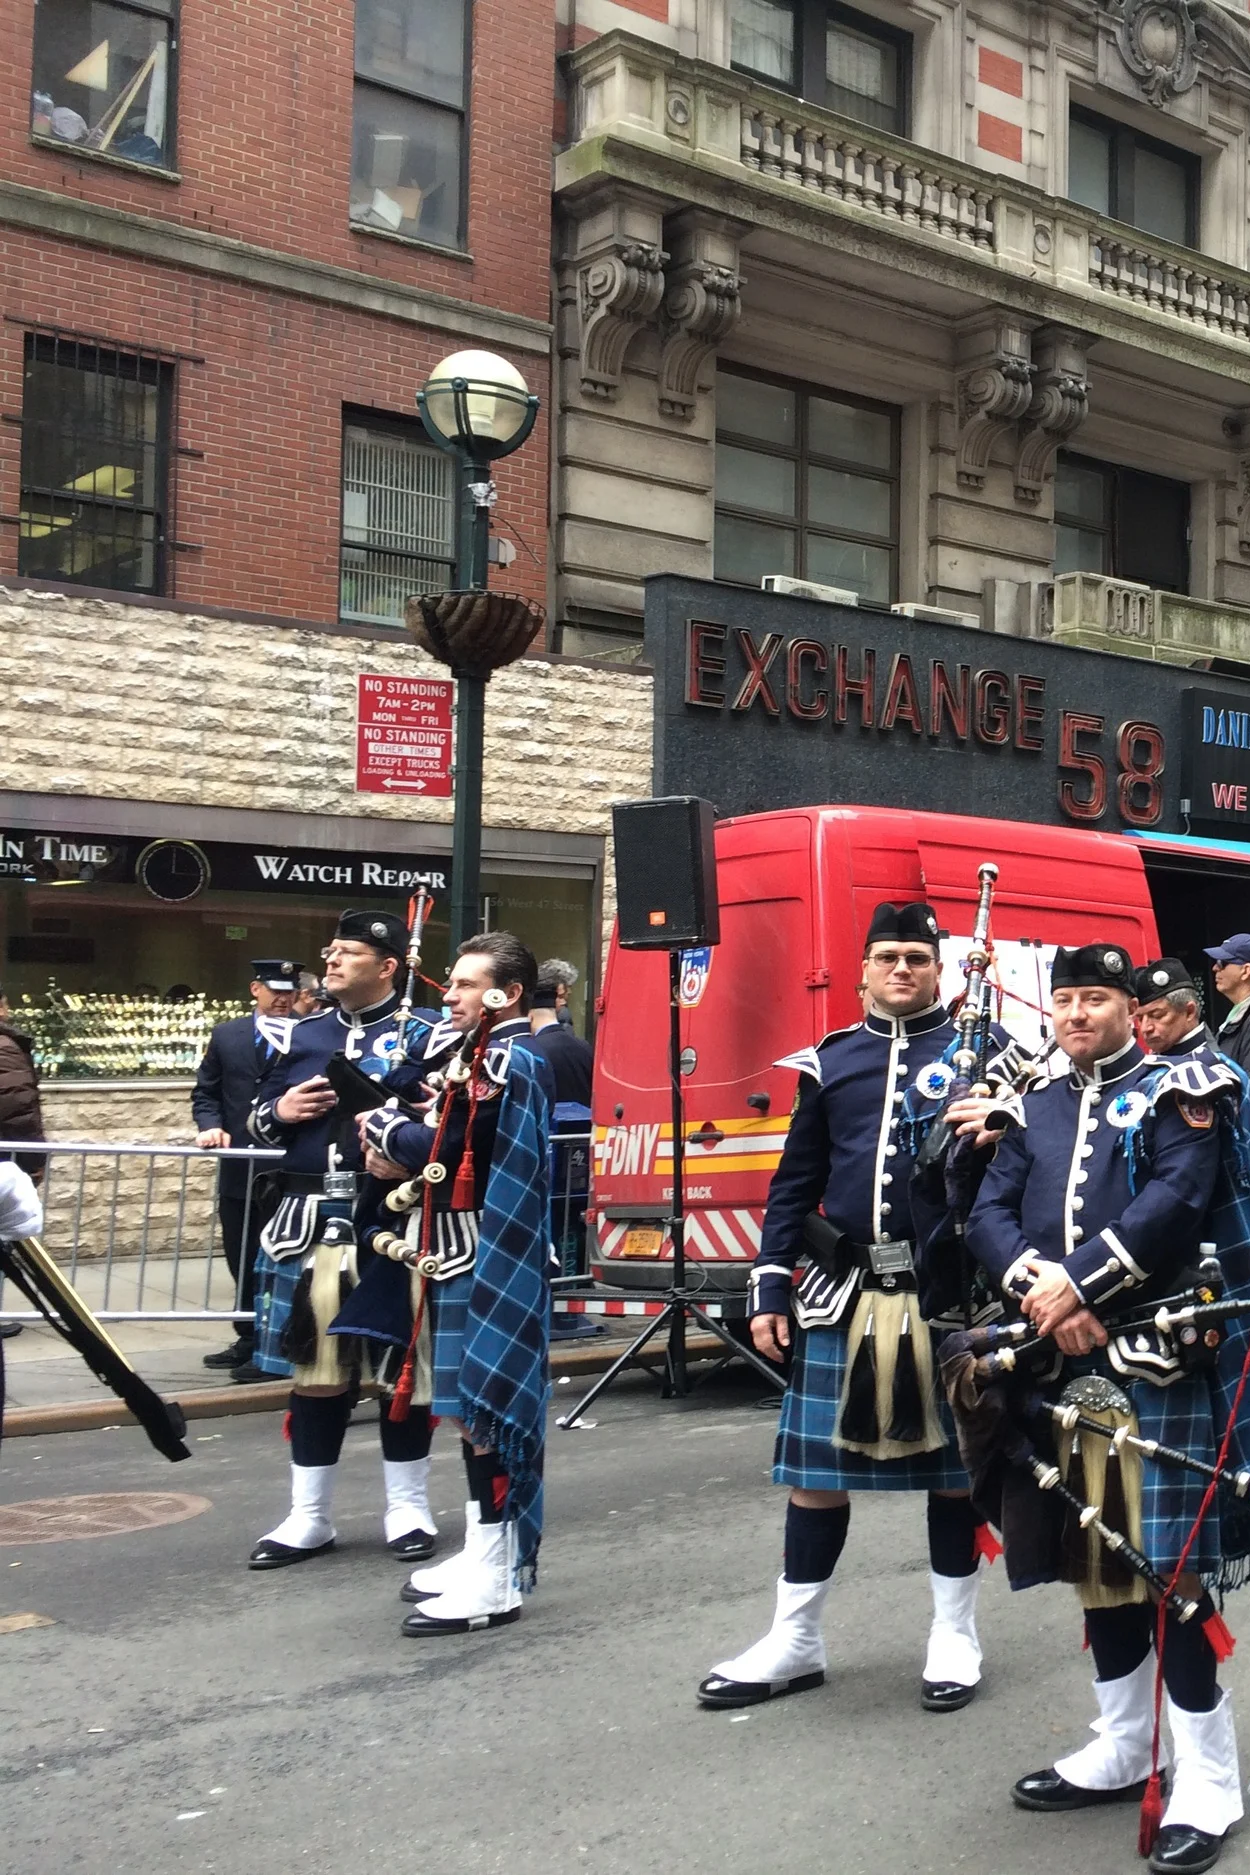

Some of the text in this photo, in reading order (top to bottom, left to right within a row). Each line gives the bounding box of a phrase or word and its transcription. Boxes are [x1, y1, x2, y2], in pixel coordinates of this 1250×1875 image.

[365, 679, 447, 697] NO STANDING
[684, 617, 1047, 752] EXCHANGE
[372, 712, 396, 722] MON
[421, 716, 439, 725] FRI
[364, 728, 446, 745] NO STANDING
[373, 744, 436, 756] OTHER TIMES
[368, 756, 440, 770] EXCEPT TRUCKS
[1057, 708, 1165, 827] 58
[362, 767, 394, 775] LOADING
[405, 770, 446, 779] UNLOADING
[1212, 782, 1248, 812] WE
[35, 835, 107, 863] TIME
[254, 855, 446, 889] WATCH REPAIR
[601, 1123, 660, 1175] FDNY
[687, 1186, 712, 1200] BACK
